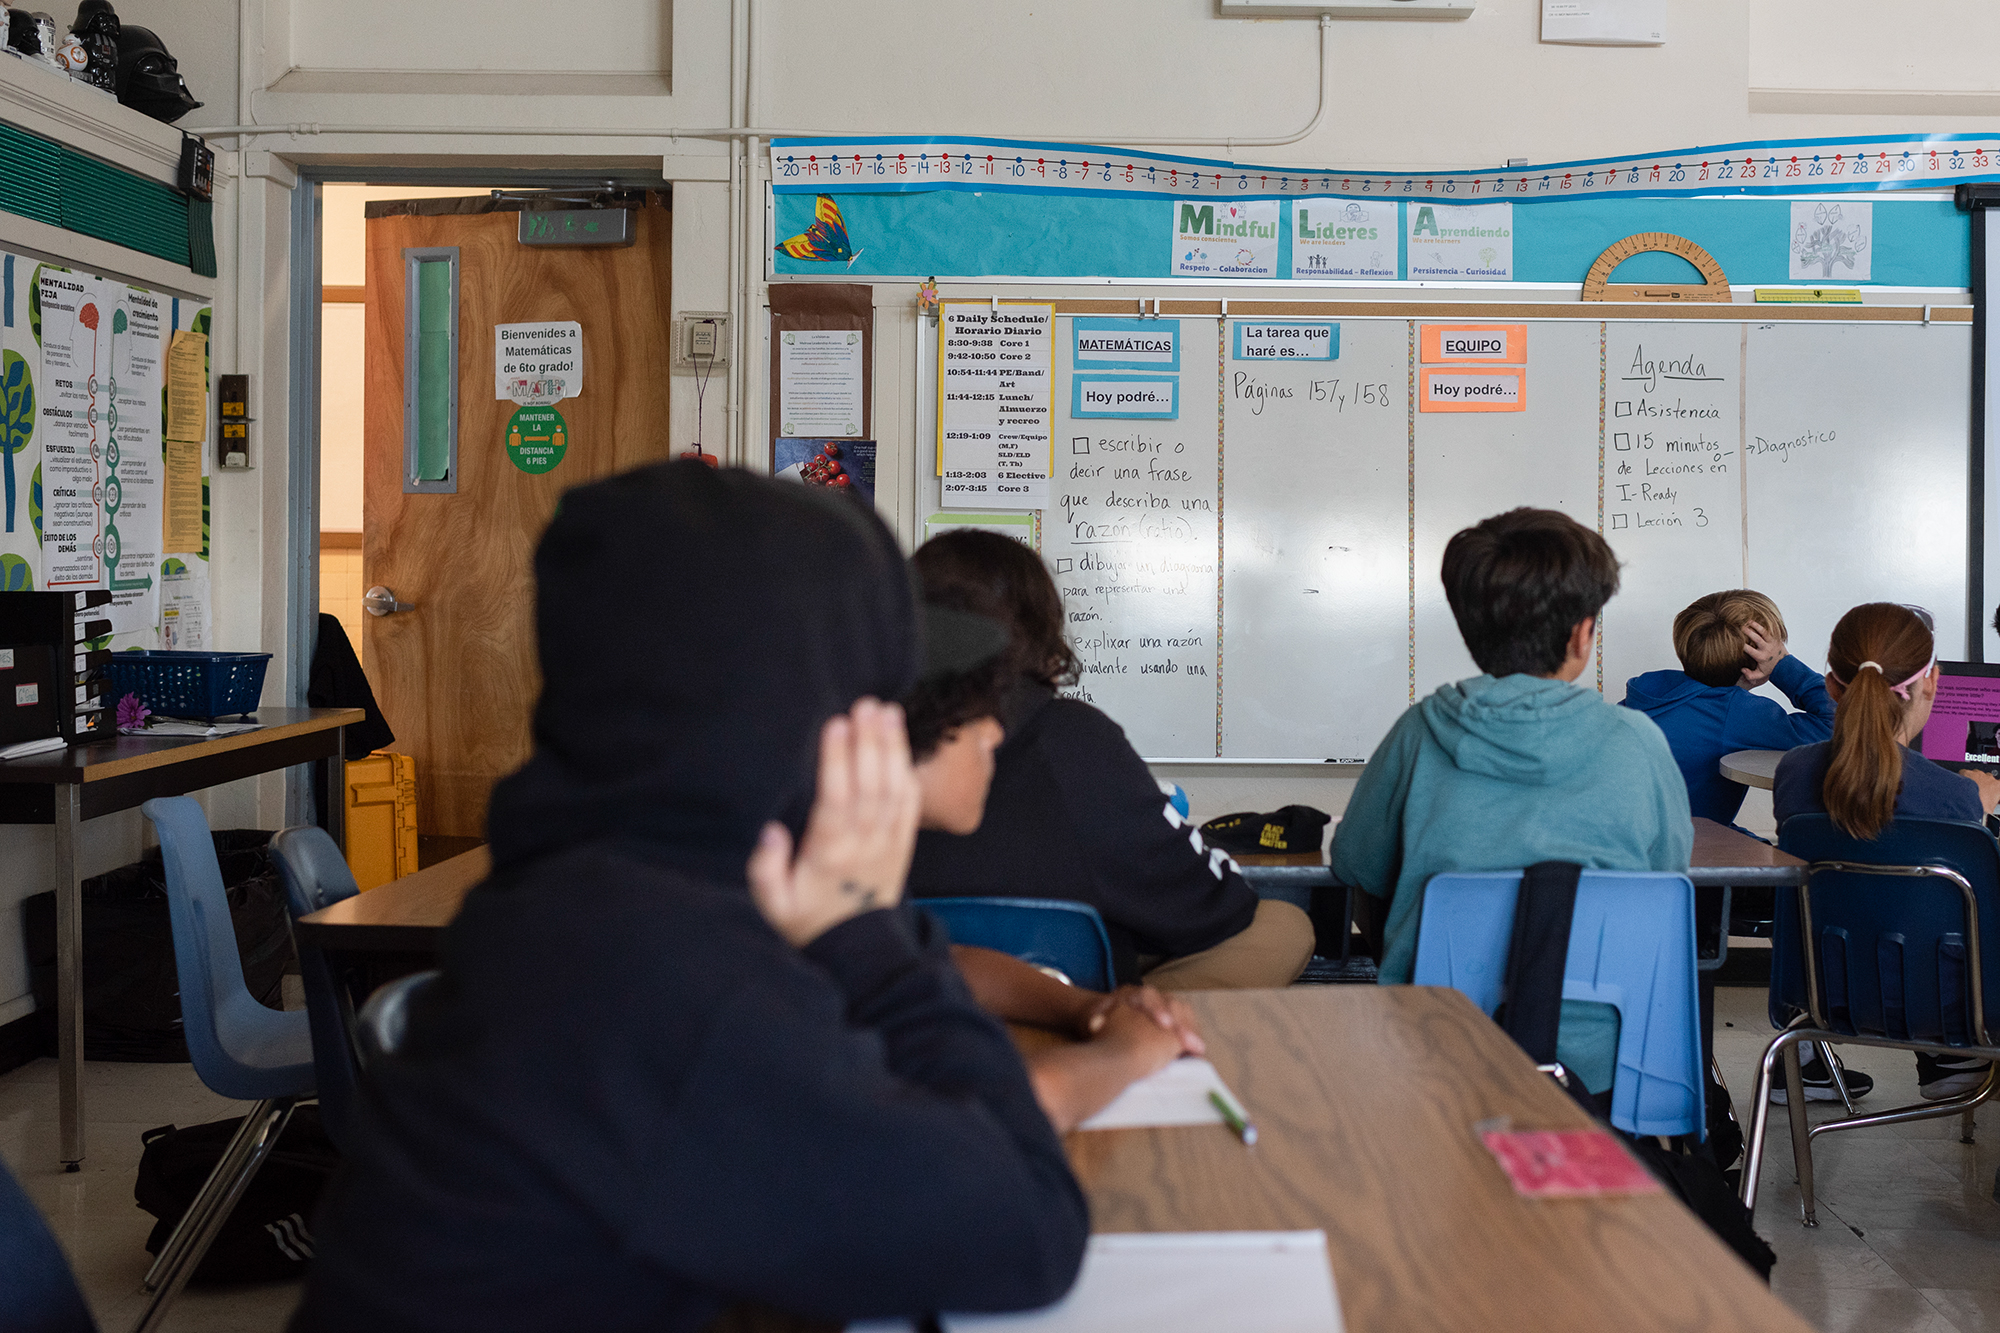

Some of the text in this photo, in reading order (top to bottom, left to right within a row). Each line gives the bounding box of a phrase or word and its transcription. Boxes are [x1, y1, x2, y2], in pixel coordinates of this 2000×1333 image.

[777, 155, 1988, 181] -20 -19 -18 -17 -16 -15 -14 -13 -12 -11 -10 21 22 23 24 25 26 27 28 29 30 31 32 33
[1179, 204, 1275, 240] Mindful
[1299, 209, 1377, 240] Líderes
[1413, 206, 1509, 239] Aprendiendo
[1180, 264, 1210, 273] Respeto
[1296, 267, 1393, 276] Responsabilidad Reflexión
[1413, 267, 1506, 276] Persistencia Curiosidad
[41, 277, 84, 293] MENTALIDAD
[41, 290, 57, 299] FIJA
[957, 315, 988, 324] Daily
[991, 315, 1049, 324] Schedule/
[502, 329, 566, 340] Bienvenides
[955, 327, 1042, 335] Horario Diario
[1247, 328, 1329, 341] La tarea que
[506, 345, 571, 356] Matemáticas
[1079, 338, 1171, 350] MATEMÁTICAS
[1446, 340, 1501, 353] EQUIPO
[1247, 345, 1309, 357] haré es...
[504, 362, 573, 374] de 6to grado!
[1631, 344, 1706, 393] Agenda
[55, 379, 73, 388] RETOS
[511, 379, 561, 398] MATH
[1234, 372, 1389, 415] Páginas 157 y 158
[1434, 384, 1516, 397] Hoy podré...
[1086, 391, 1168, 404] Hoy podré...
[43, 406, 72, 418] OBSTÁCULOS
[1637, 398, 1720, 419] Asistencia
[46, 445, 75, 453] ESFUERZO
[1099, 434, 1184, 453] escribir o
[1637, 433, 1719, 452] 15 minutos
[1755, 430, 1836, 463] Diagnostico
[1070, 458, 1191, 481] decir una frase
[1618, 458, 1726, 476] de Lecciones en
[53, 487, 76, 496] CRÍTICAS
[1060, 491, 1212, 523] que describa una
[1694, 508, 1708, 527] 3
[1075, 516, 1131, 539] razón
[44, 531, 57, 541] ÉXITO
[58, 543, 76, 552] DEMÁS
[1063, 587, 1089, 611] para
[1069, 607, 1102, 623] razón.
[1140, 637, 1162, 647] una
[1167, 629, 1202, 646] razón
[1141, 658, 1208, 676] usando una
[1965, 752, 2000, 763] Excellent
